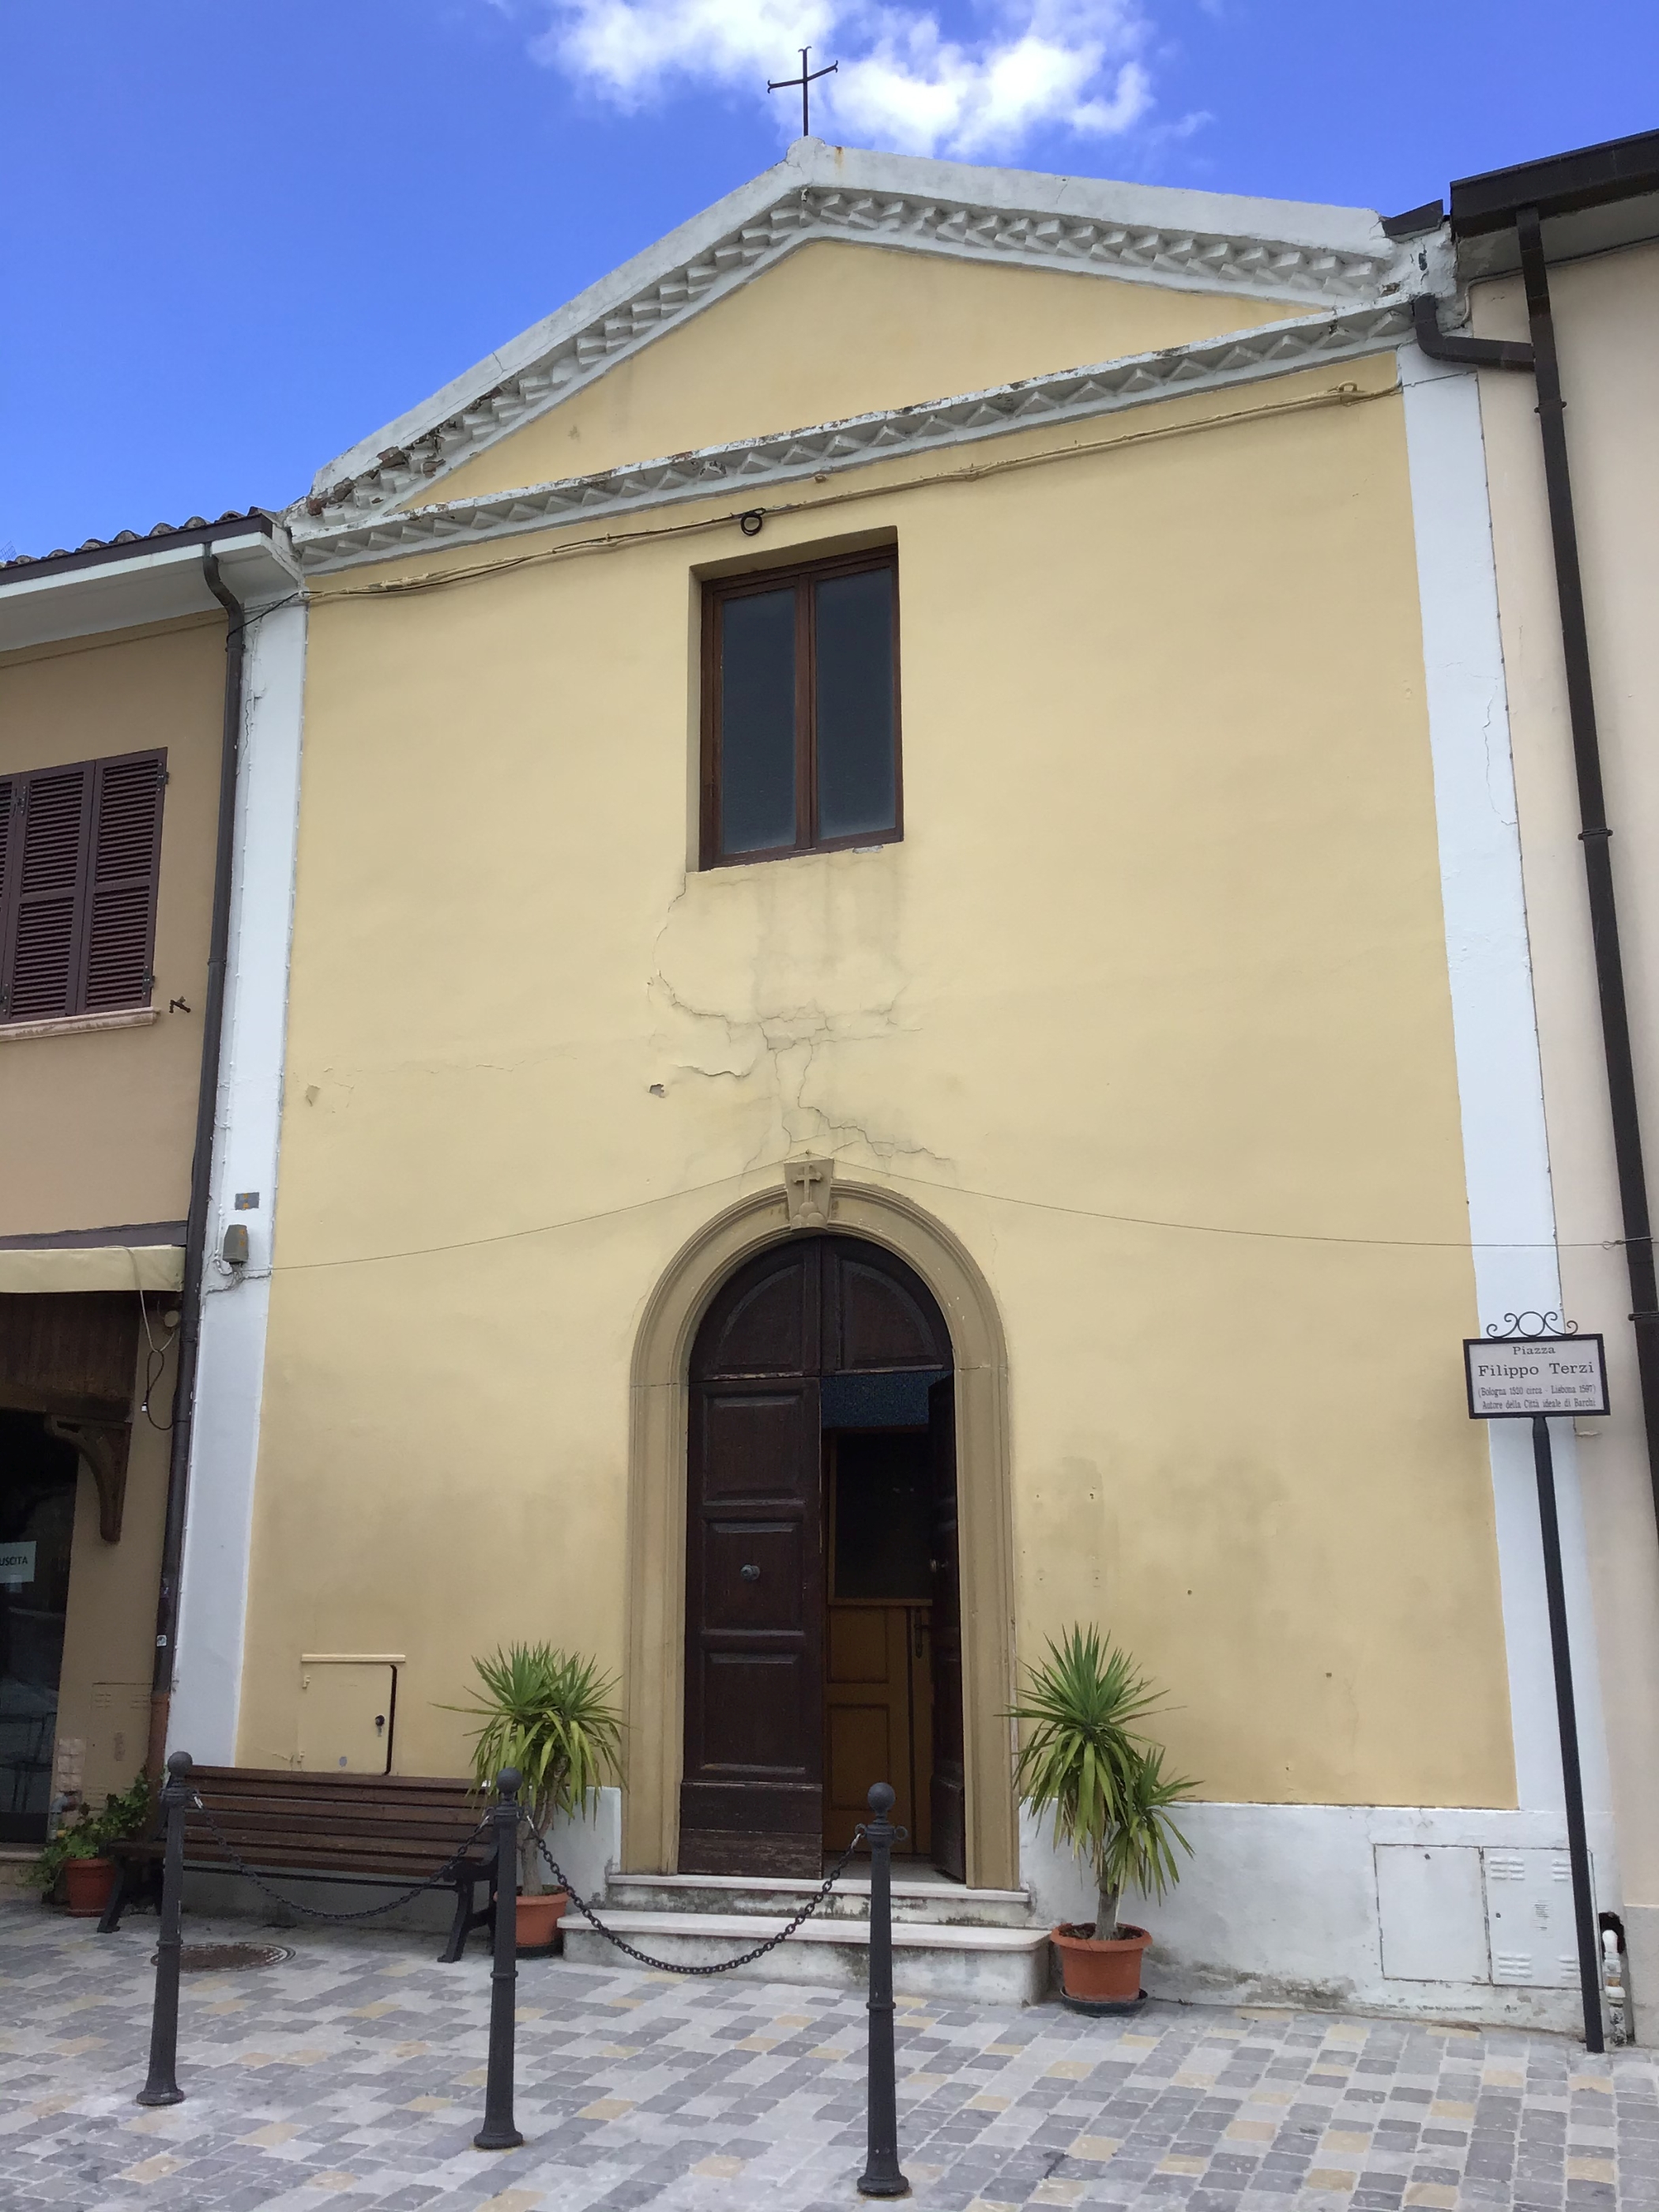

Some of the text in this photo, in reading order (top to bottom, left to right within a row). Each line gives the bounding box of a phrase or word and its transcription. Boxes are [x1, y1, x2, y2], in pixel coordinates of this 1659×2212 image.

[1512, 1345, 1556, 1356] Piazza
[1477, 1361, 1594, 1379] Filippo Terzi
[1477, 1387, 1507, 1398] (Bologna
[1509, 1386, 1524, 1396] 1520
[1525, 1386, 1543, 1395] circa
[1551, 1385, 1576, 1394] Lisbona
[1482, 1401, 1503, 1410] Autore
[1506, 1400, 1522, 1409] della
[1542, 1398, 1562, 1408] ideale
[1564, 1398, 1571, 1408] di
[0, 1556, 28, 1567] USCITA
